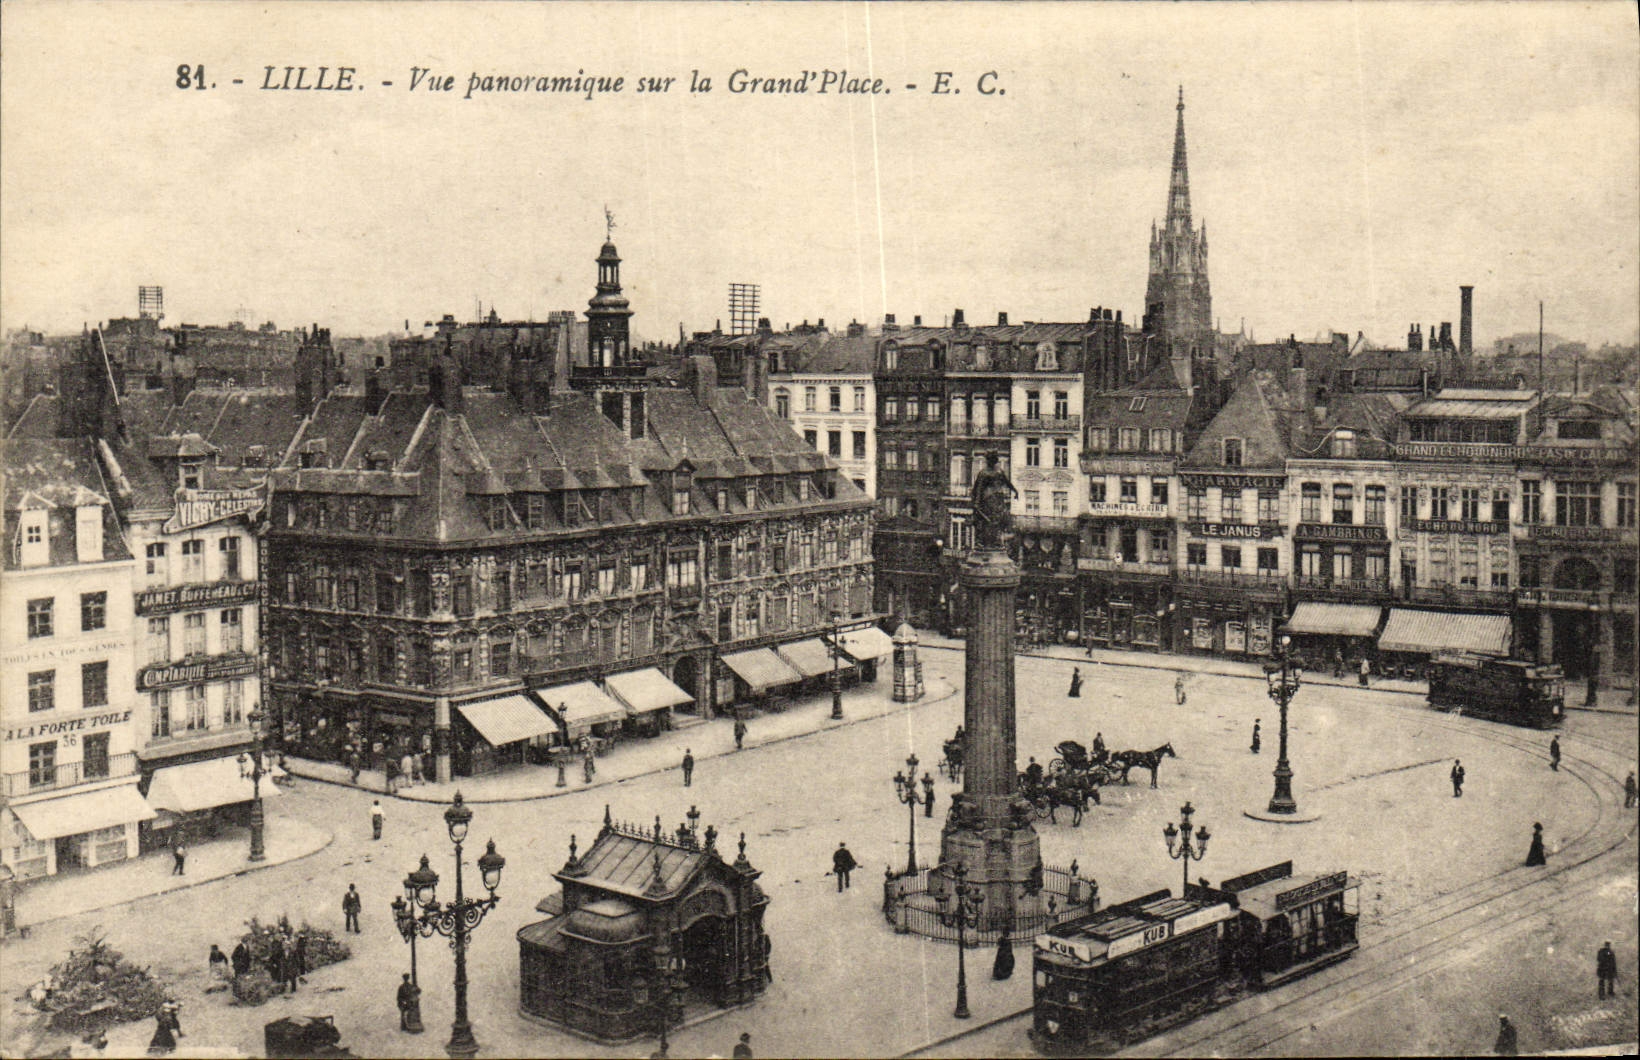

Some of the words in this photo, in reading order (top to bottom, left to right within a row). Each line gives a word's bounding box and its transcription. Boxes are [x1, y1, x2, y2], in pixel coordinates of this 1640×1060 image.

[1202, 525, 1217, 536] LE
[1220, 525, 1261, 537] JANUS
[17, 727, 35, 740] LA
[39, 718, 87, 736] FORTE
[91, 710, 132, 729] TOILE
[62, 734, 77, 747] 36
[1143, 924, 1166, 947] KUB
[1048, 940, 1076, 956] KUB
